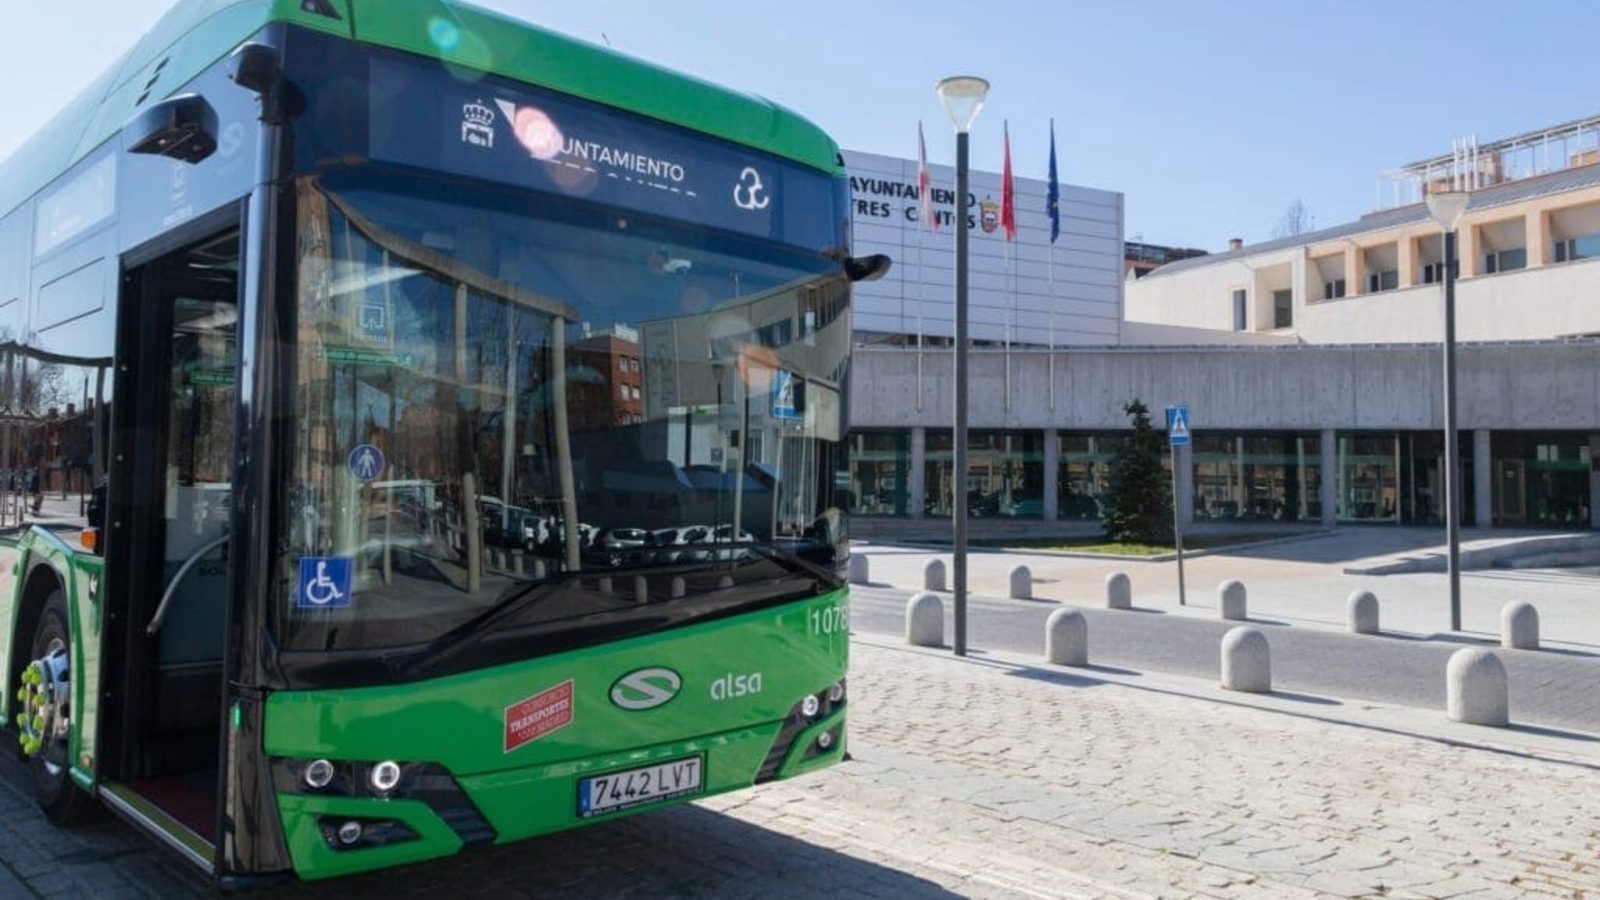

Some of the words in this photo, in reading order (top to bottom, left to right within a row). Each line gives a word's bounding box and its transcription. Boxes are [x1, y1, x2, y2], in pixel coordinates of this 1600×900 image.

[534, 124, 685, 182] UNTAMIENTO
[850, 176, 976, 208] AYUNTAIENO
[851, 199, 890, 218] RES
[905, 206, 976, 229] CNTS
[710, 672, 762, 700] alsa
[595, 771, 652, 806] 7442
[658, 761, 698, 792] LVT
